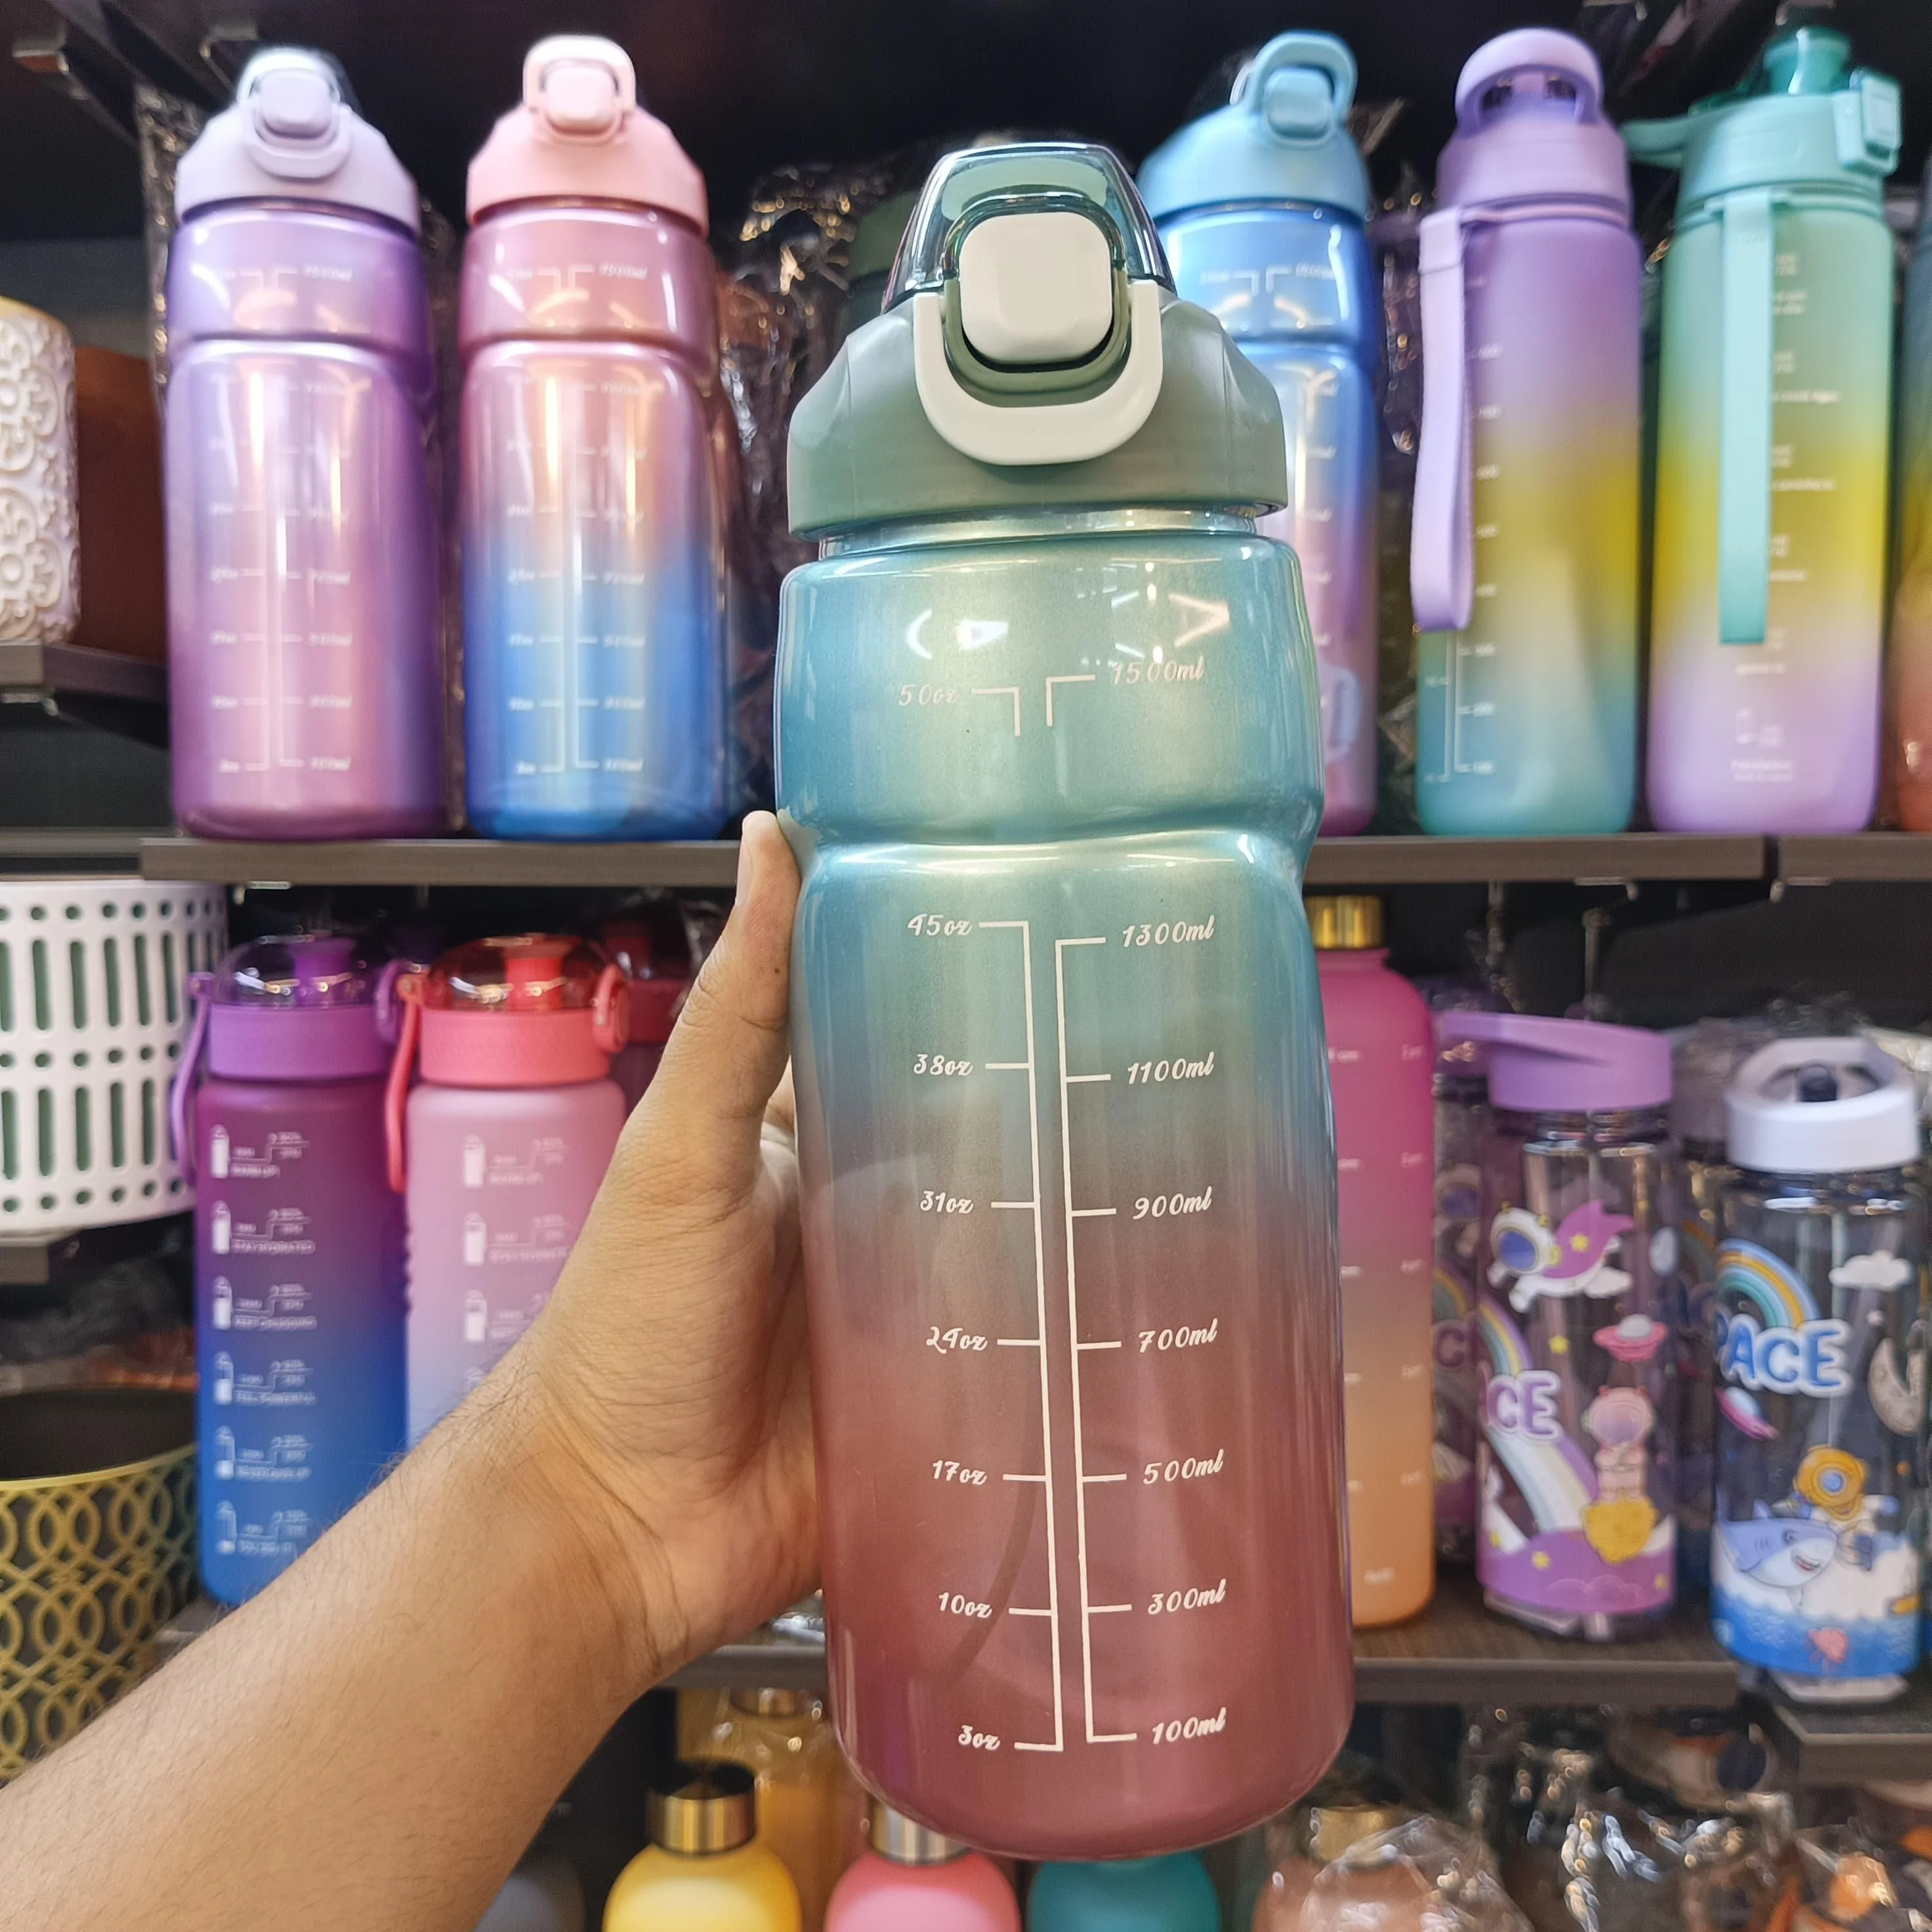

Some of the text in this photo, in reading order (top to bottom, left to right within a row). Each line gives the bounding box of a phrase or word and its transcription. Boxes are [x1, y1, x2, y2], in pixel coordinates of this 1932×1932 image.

[1112, 656, 1205, 684] 1500ml
[898, 684, 959, 706] 50oz
[907, 913, 973, 936] 45oz
[1122, 914, 1215, 948] 1300ml
[913, 1053, 973, 1077] 38oz
[1127, 1051, 1215, 1085] 1100ml
[919, 1190, 974, 1214] 31oz
[1132, 1186, 1213, 1219] 900ml
[925, 1326, 988, 1354] 24oz
[1137, 1317, 1219, 1353] 700ml
[1482, 1370, 1561, 1440] CE
[932, 1460, 988, 1486] 17oz
[1142, 1448, 1225, 1485] 500ml
[938, 1591, 994, 1619] 10oz
[1146, 1578, 1227, 1616] 300ml
[957, 1724, 1001, 1751] 3oz
[1151, 1706, 1227, 1745] 100ml
